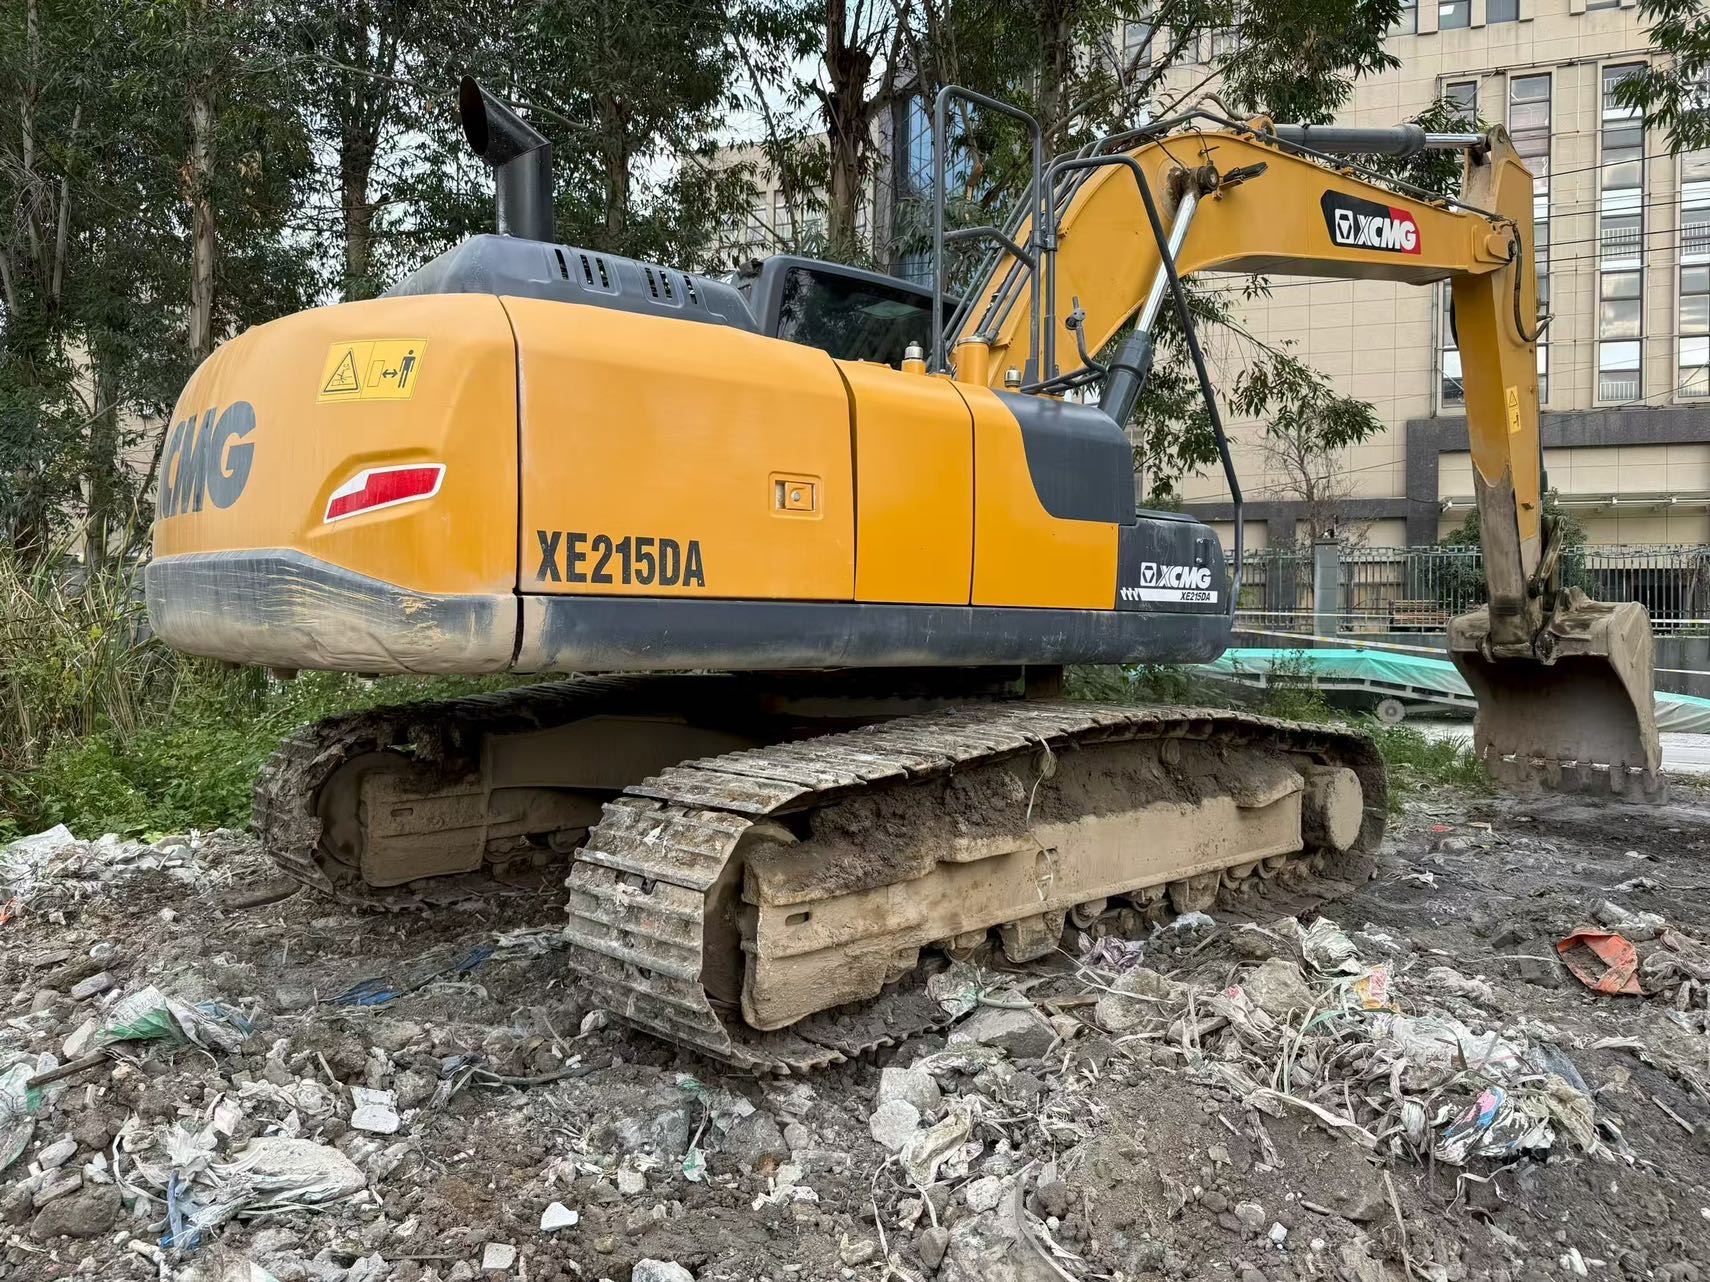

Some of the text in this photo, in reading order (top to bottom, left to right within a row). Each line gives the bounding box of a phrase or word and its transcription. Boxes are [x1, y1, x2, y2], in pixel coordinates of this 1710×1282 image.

[1355, 214, 1416, 251] XCMG
[160, 400, 257, 519] CMG
[536, 530, 706, 588] XE215DA
[1156, 565, 1211, 589] XCMG
[1180, 591, 1211, 601] XE215DA
